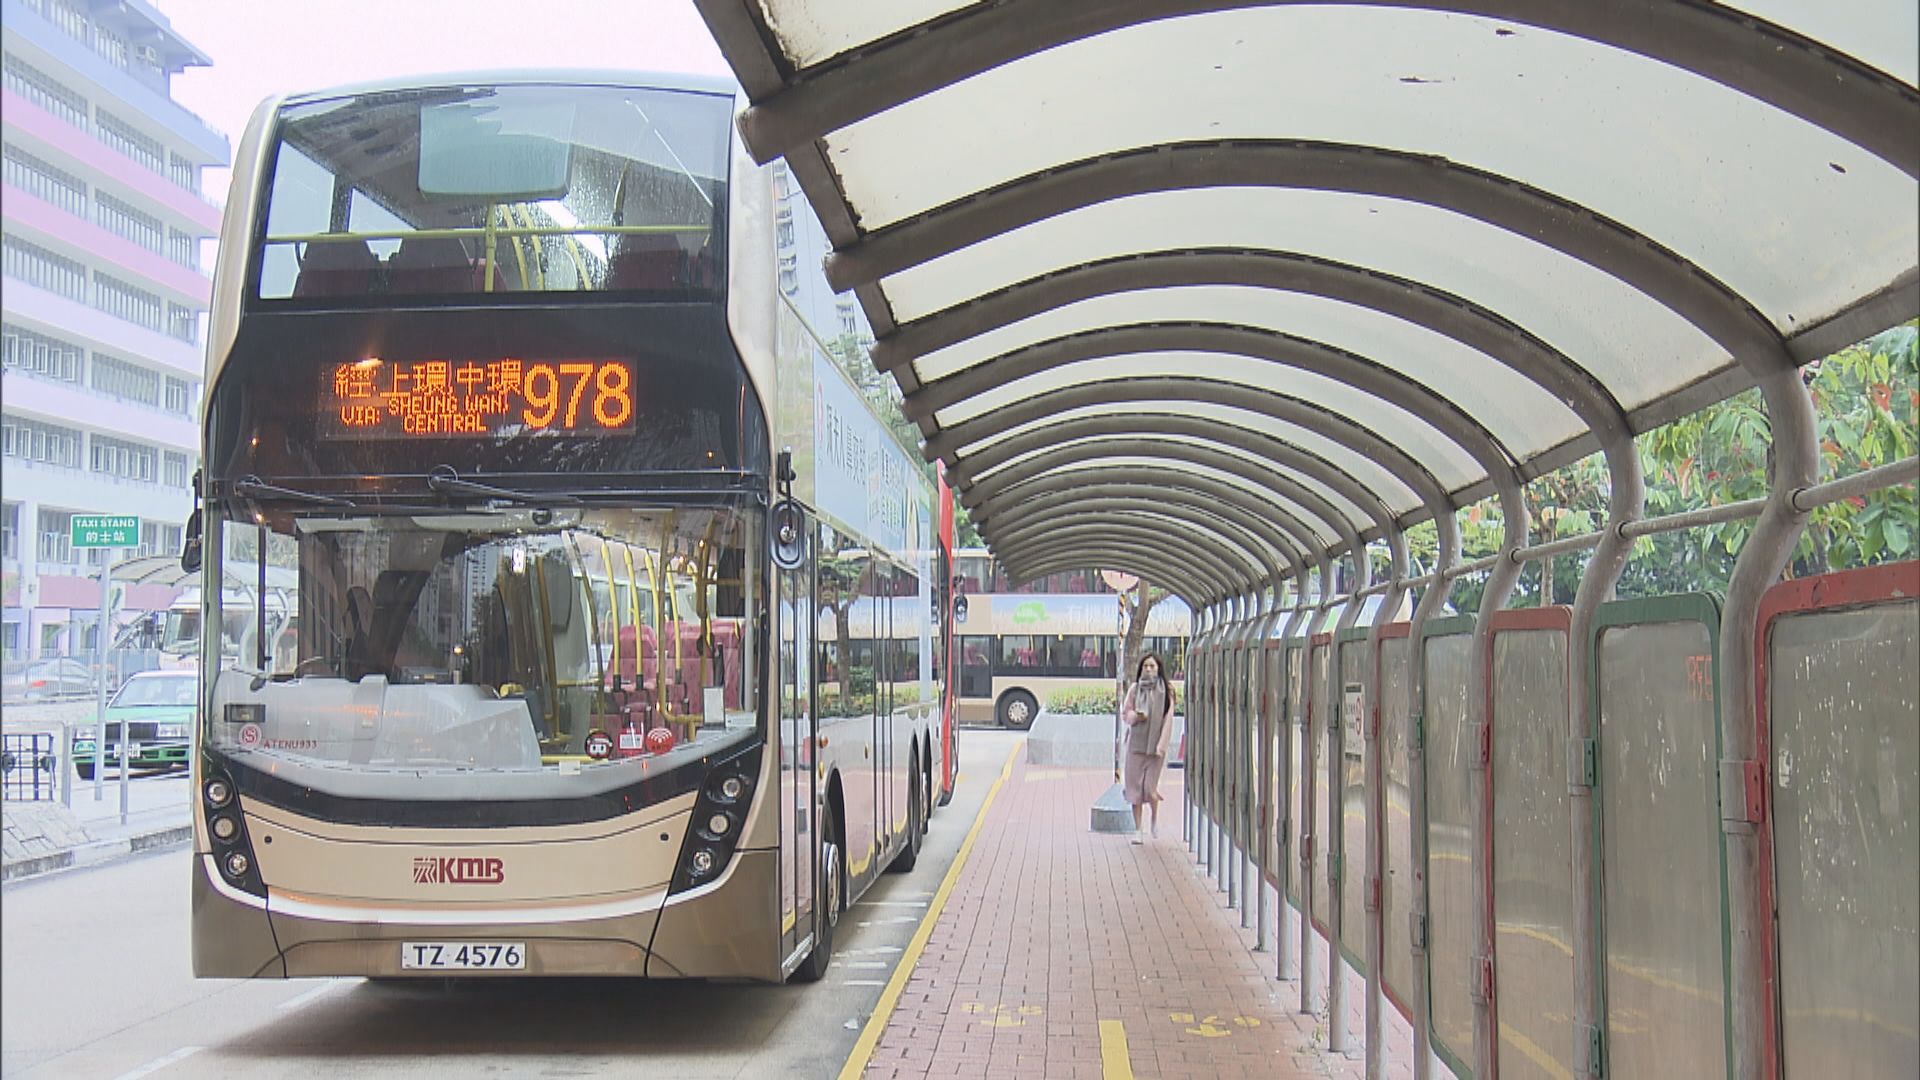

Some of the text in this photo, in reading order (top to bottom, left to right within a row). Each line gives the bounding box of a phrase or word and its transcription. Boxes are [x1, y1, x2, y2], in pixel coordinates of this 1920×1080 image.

[523, 362, 631, 428] 978
[341, 405, 381, 425] VIA:
[388, 395, 458, 415] SHEUNG
[403, 413, 487, 433] CENTRAL
[76, 518, 135, 528] TAXI STAND
[86, 530, 125, 544] 的士站
[439, 857, 505, 884] KMB
[413, 945, 521, 966] TZ 4576
